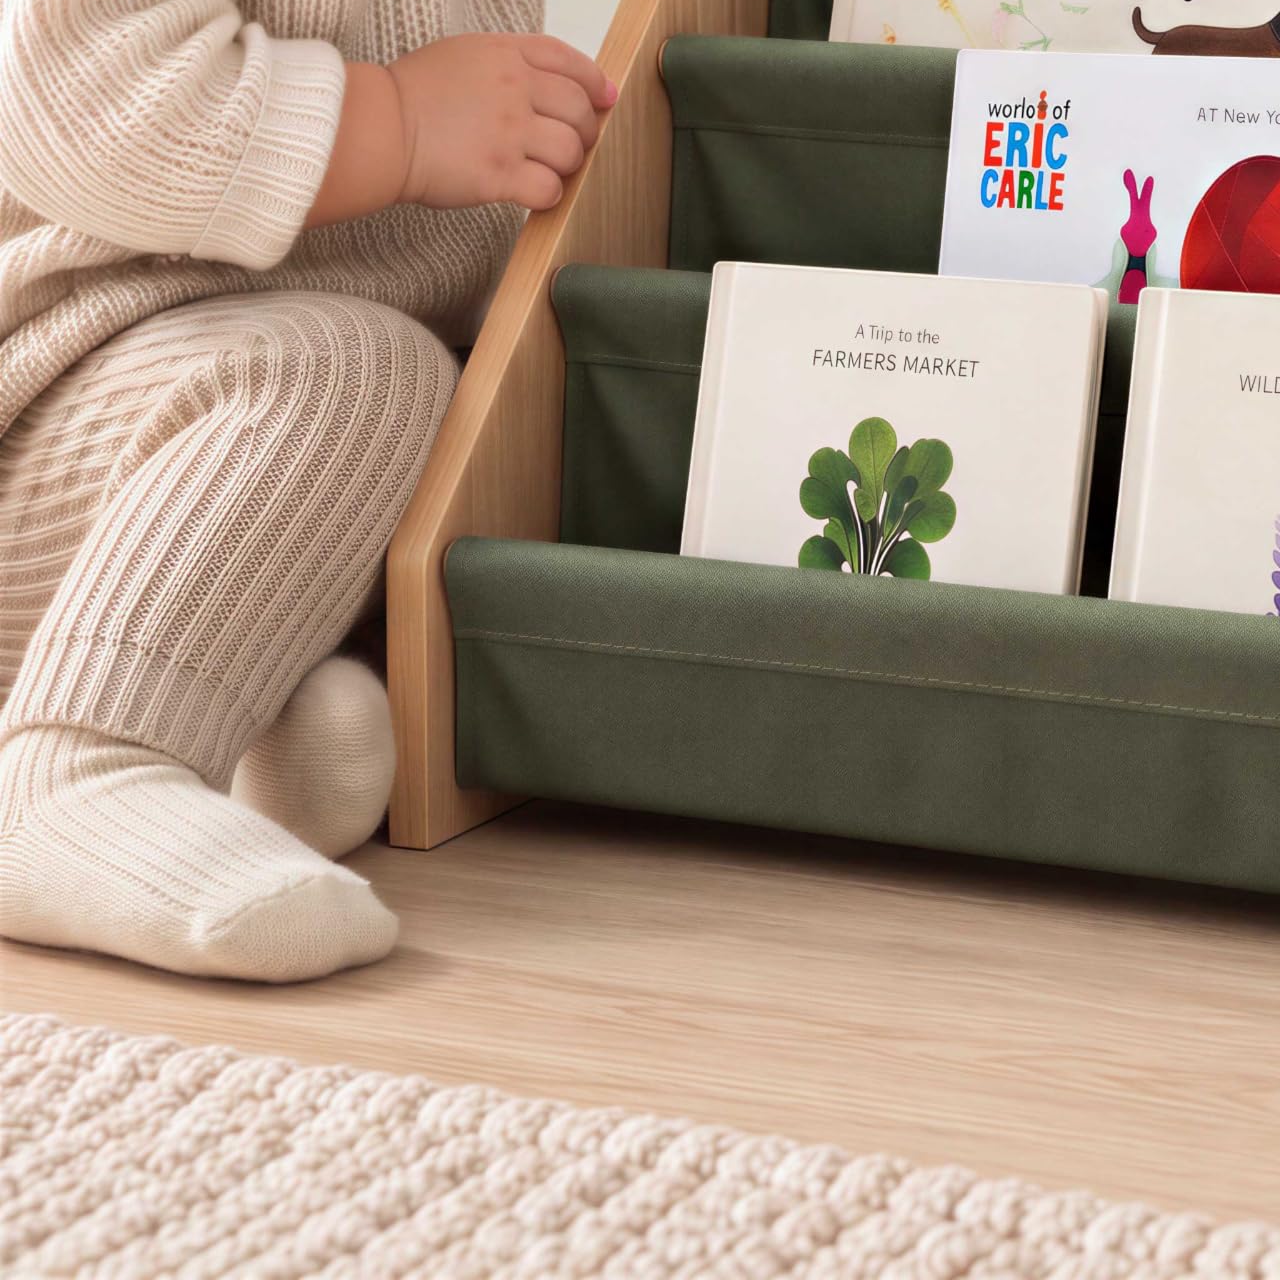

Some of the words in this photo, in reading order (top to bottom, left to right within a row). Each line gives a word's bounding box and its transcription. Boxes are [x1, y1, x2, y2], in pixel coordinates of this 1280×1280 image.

[1052, 99, 1071, 121] of
[1224, 108, 1260, 124] New
[983, 121, 1069, 170] ERIC
[980, 168, 1065, 211] CARLE
[854, 324, 865, 340] A
[899, 328, 912, 343] to
[917, 328, 940, 345] the
[812, 349, 897, 372] FARMERS
[903, 355, 980, 379] MARKET
